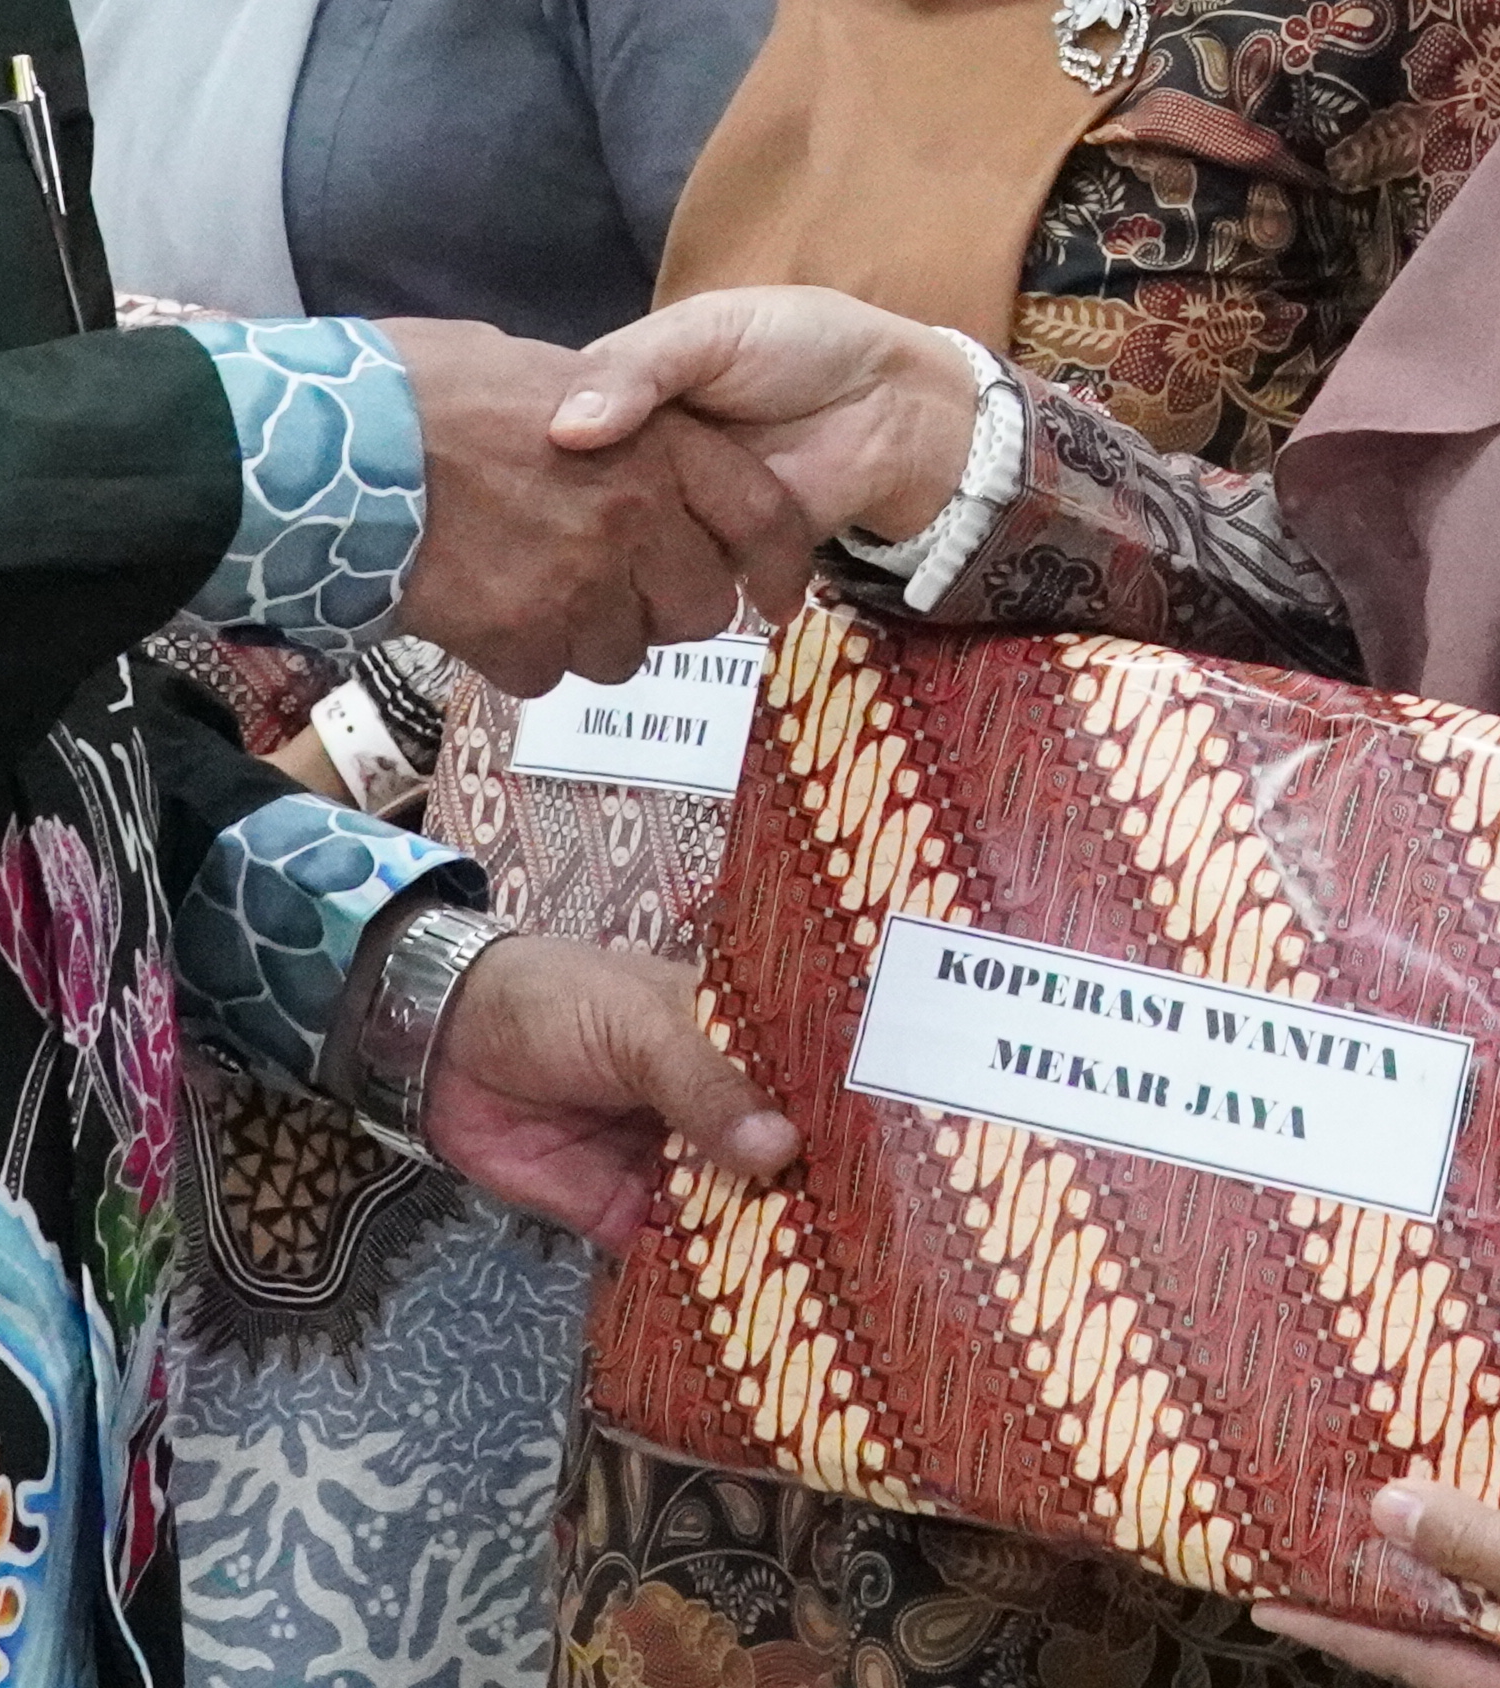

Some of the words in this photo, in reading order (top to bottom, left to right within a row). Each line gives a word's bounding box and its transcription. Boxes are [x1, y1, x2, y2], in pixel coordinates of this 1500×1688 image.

[674, 652, 759, 688] WANIT
[577, 707, 633, 738] ARGA
[641, 713, 709, 746] DEWI
[936, 948, 1186, 1033] KOPERASI
[1205, 1007, 1398, 1081] WANITA
[989, 1038, 1170, 1107] MEKAR
[1184, 1083, 1306, 1140] JAYA
